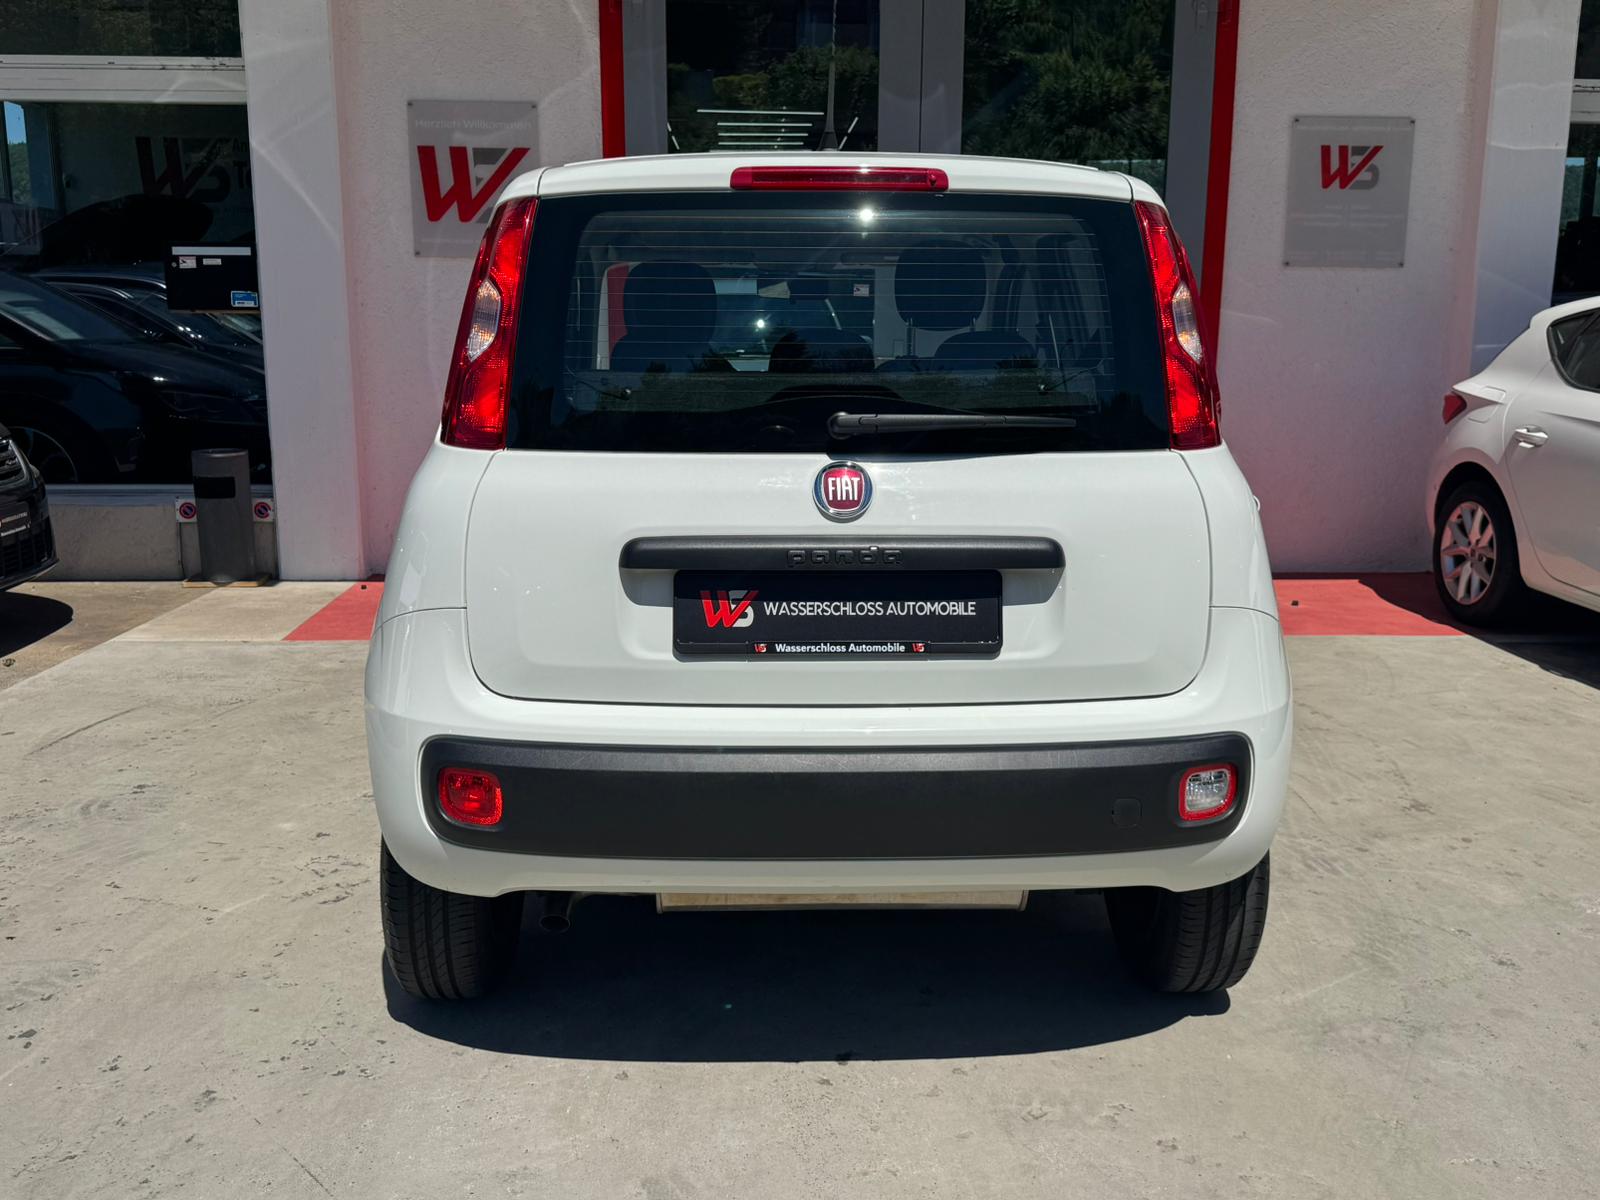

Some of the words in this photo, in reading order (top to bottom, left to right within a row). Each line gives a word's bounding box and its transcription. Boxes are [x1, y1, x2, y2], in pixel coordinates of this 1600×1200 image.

[828, 476, 860, 501] FIAT
[787, 547, 903, 568] panda
[763, 601, 884, 616] WASSERSCHLOSS
[886, 601, 976, 616] AUTOMOBILE
[775, 643, 847, 653] Wasserschloss
[849, 642, 906, 653] Automobile
